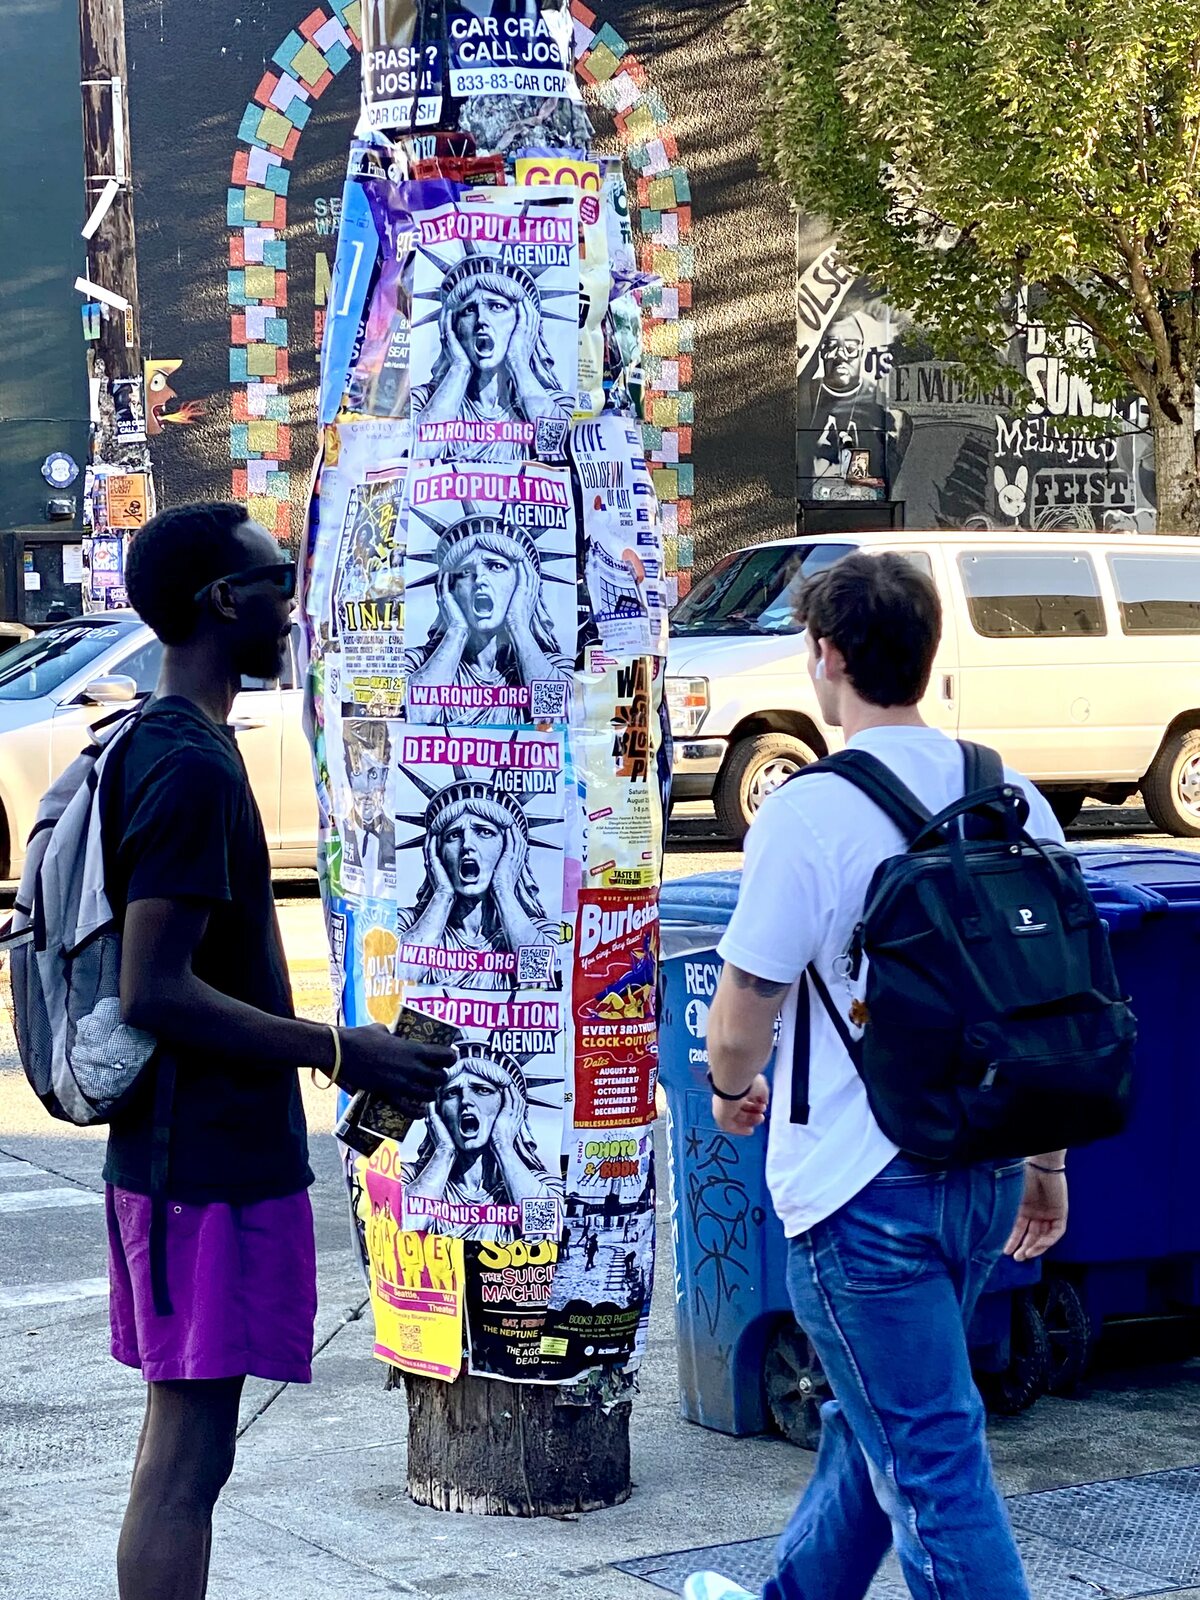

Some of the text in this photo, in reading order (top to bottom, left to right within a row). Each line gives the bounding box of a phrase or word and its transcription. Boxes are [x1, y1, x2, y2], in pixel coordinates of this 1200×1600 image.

[451, 17, 550, 39] CAR CRA
[460, 41, 560, 62] CALL JOS
[457, 73, 540, 91] 833-83-CAR
[422, 214, 571, 243] DEPOPULATION
[503, 245, 569, 266] AGENDA
[421, 421, 534, 442] WARONUS.ORG
[573, 423, 606, 453] LIVE
[416, 475, 566, 503] DEPOPULATION
[1035, 471, 1129, 505] FEIST
[616, 489, 632, 510] ART
[504, 504, 566, 528] AGENDA
[412, 686, 529, 706] WARONUS.ORG
[405, 738, 558, 767] DEPOPULATION
[493, 770, 556, 793] AGENDA
[614, 871, 633, 879] TASTE
[402, 945, 515, 971] WARONUS.ORG
[582, 1025, 618, 1036] EVERY
[619, 1024, 637, 1035] 3RD
[491, 1030, 554, 1053] AGENDA
[582, 1036, 642, 1047] CLOCK-OUT
[583, 1056, 610, 1068] Dates
[599, 1067, 627, 1075] AUGUST
[594, 1077, 634, 1086] SEPTEMBER
[597, 1087, 630, 1095] OCTOBER
[593, 1097, 631, 1106] NOVEMBER
[594, 1106, 631, 1116] DECEMBER
[585, 1140, 637, 1159] PHOTO
[408, 1197, 518, 1223] WARONUS.ORG
[480, 1272, 502, 1284] THE
[442, 1293, 455, 1303] WA
[428, 1304, 455, 1315] Theater
[482, 1324, 539, 1338] THE NEPTUNE
[506, 1345, 521, 1356] THE
[516, 1357, 540, 1365] DEAD
